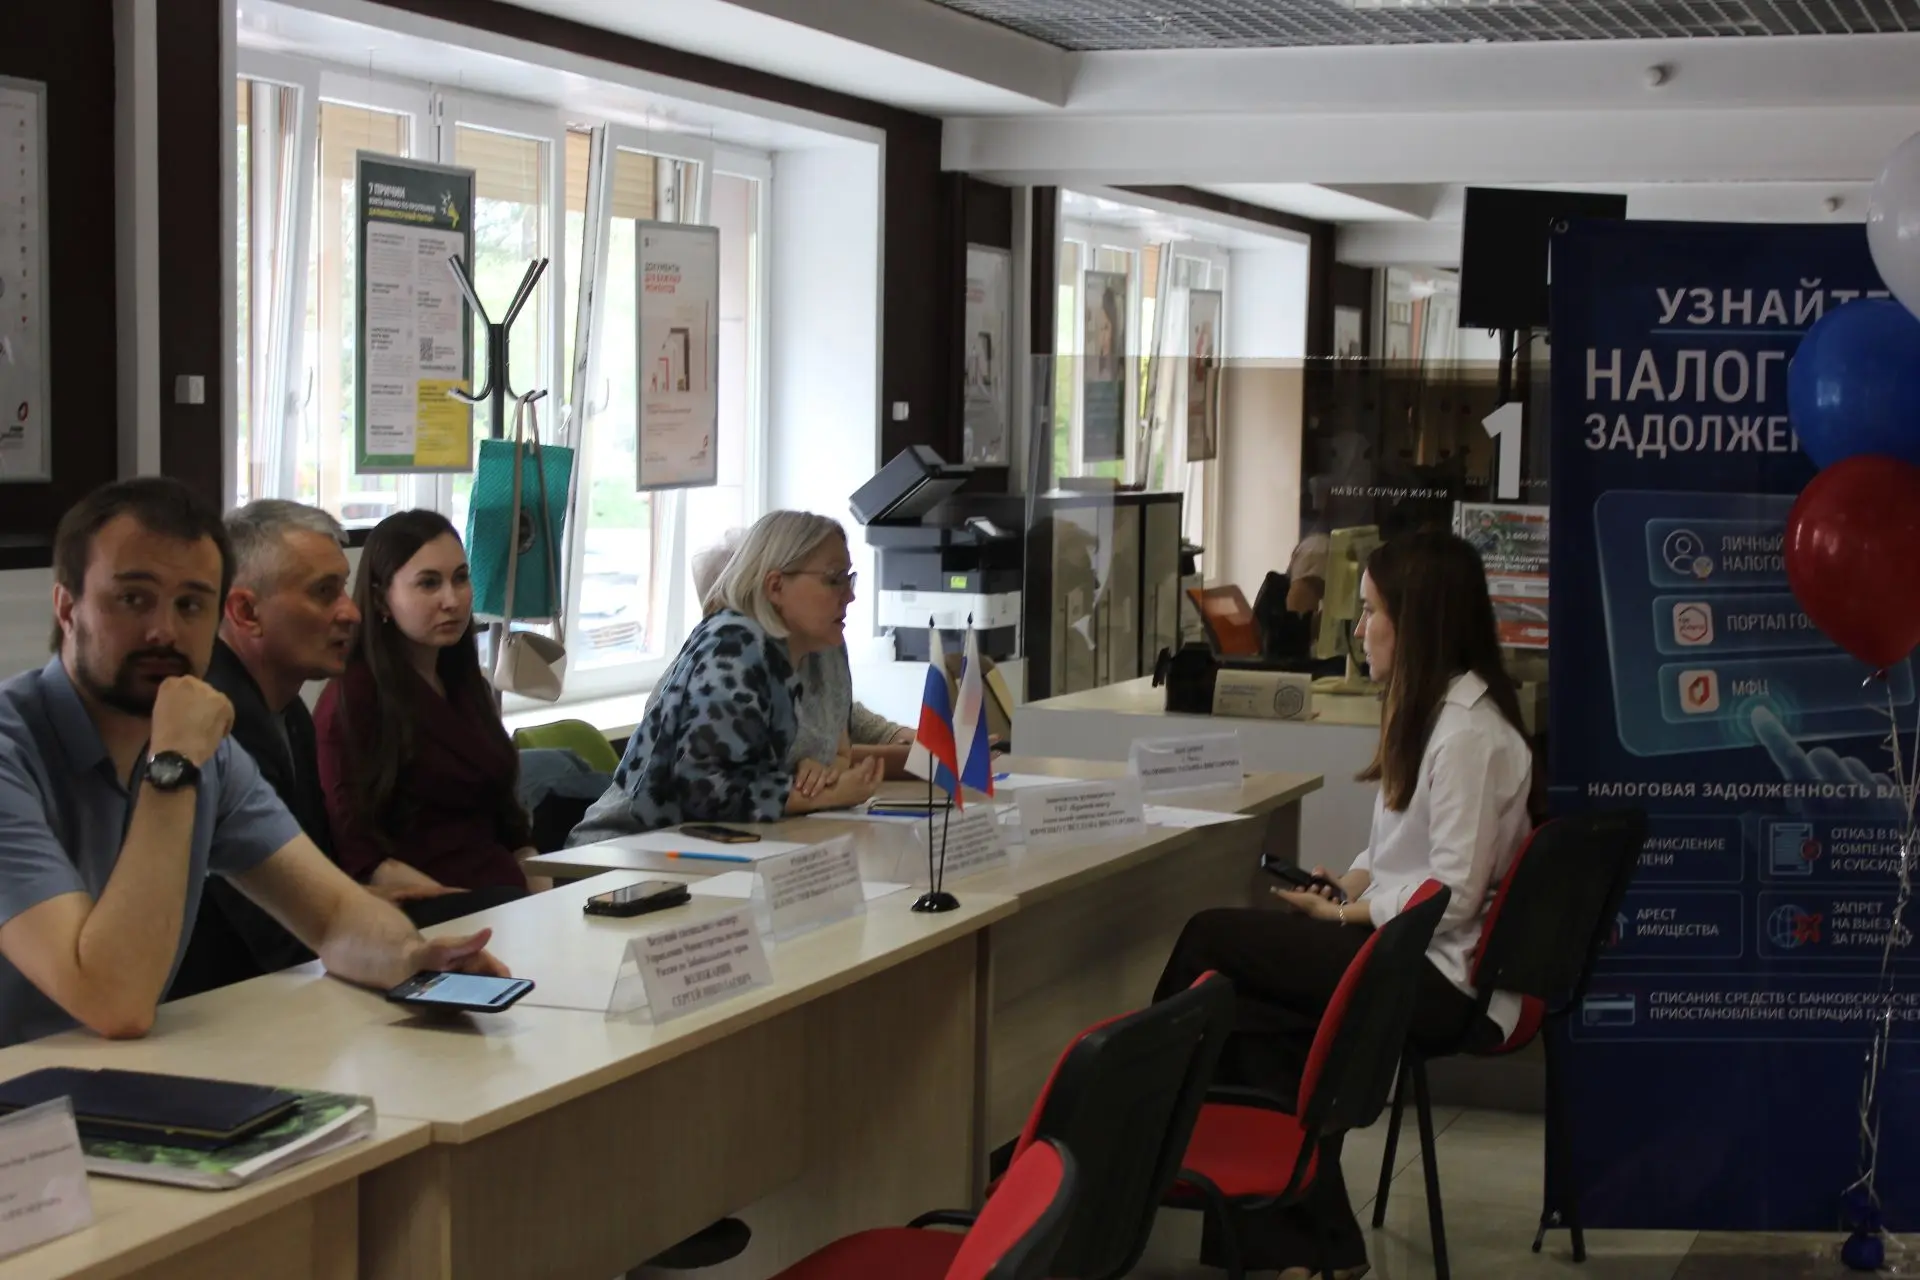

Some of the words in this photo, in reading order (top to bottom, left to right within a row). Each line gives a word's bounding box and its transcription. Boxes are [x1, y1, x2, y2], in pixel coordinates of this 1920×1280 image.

[367, 181, 374, 195] 7
[1656, 277, 1889, 325] УЗНАЙ
[1585, 348, 1793, 403] НАЛОГ
[1584, 413, 1798, 460] ЗАДОЛЖЕ
[1481, 401, 1523, 499] 1
[1727, 613, 1787, 632] ПОРТАЛ
[1731, 679, 1769, 697] МФЦ
[1587, 782, 1696, 798] НАЛОГОВАЯ
[1701, 782, 1871, 801] ЗАДОЛЖЕННОСТЬ
[1831, 827, 1875, 841] ОТКАЗ
[1831, 859, 1841, 870] И
[1636, 907, 1678, 921] АРЕСТ
[1832, 902, 1883, 915] ЗАПРЕТ
[1636, 923, 1720, 940] ИМУЩЕСТВА
[1832, 917, 1850, 930] НА
[1853, 917, 1902, 931] ВЫЕЗ
[1832, 931, 1849, 945] ЗА
[1650, 991, 1723, 1004] СПИСАНИЕ
[1725, 991, 1784, 1006] СРЕДСТВ
[1787, 992, 1798, 1005] С
[1650, 1006, 1785, 1021] ПРИОСТАНОВЛЕНИЕ
[1788, 1005, 1863, 1023] ОПЕРАЦИЙ
